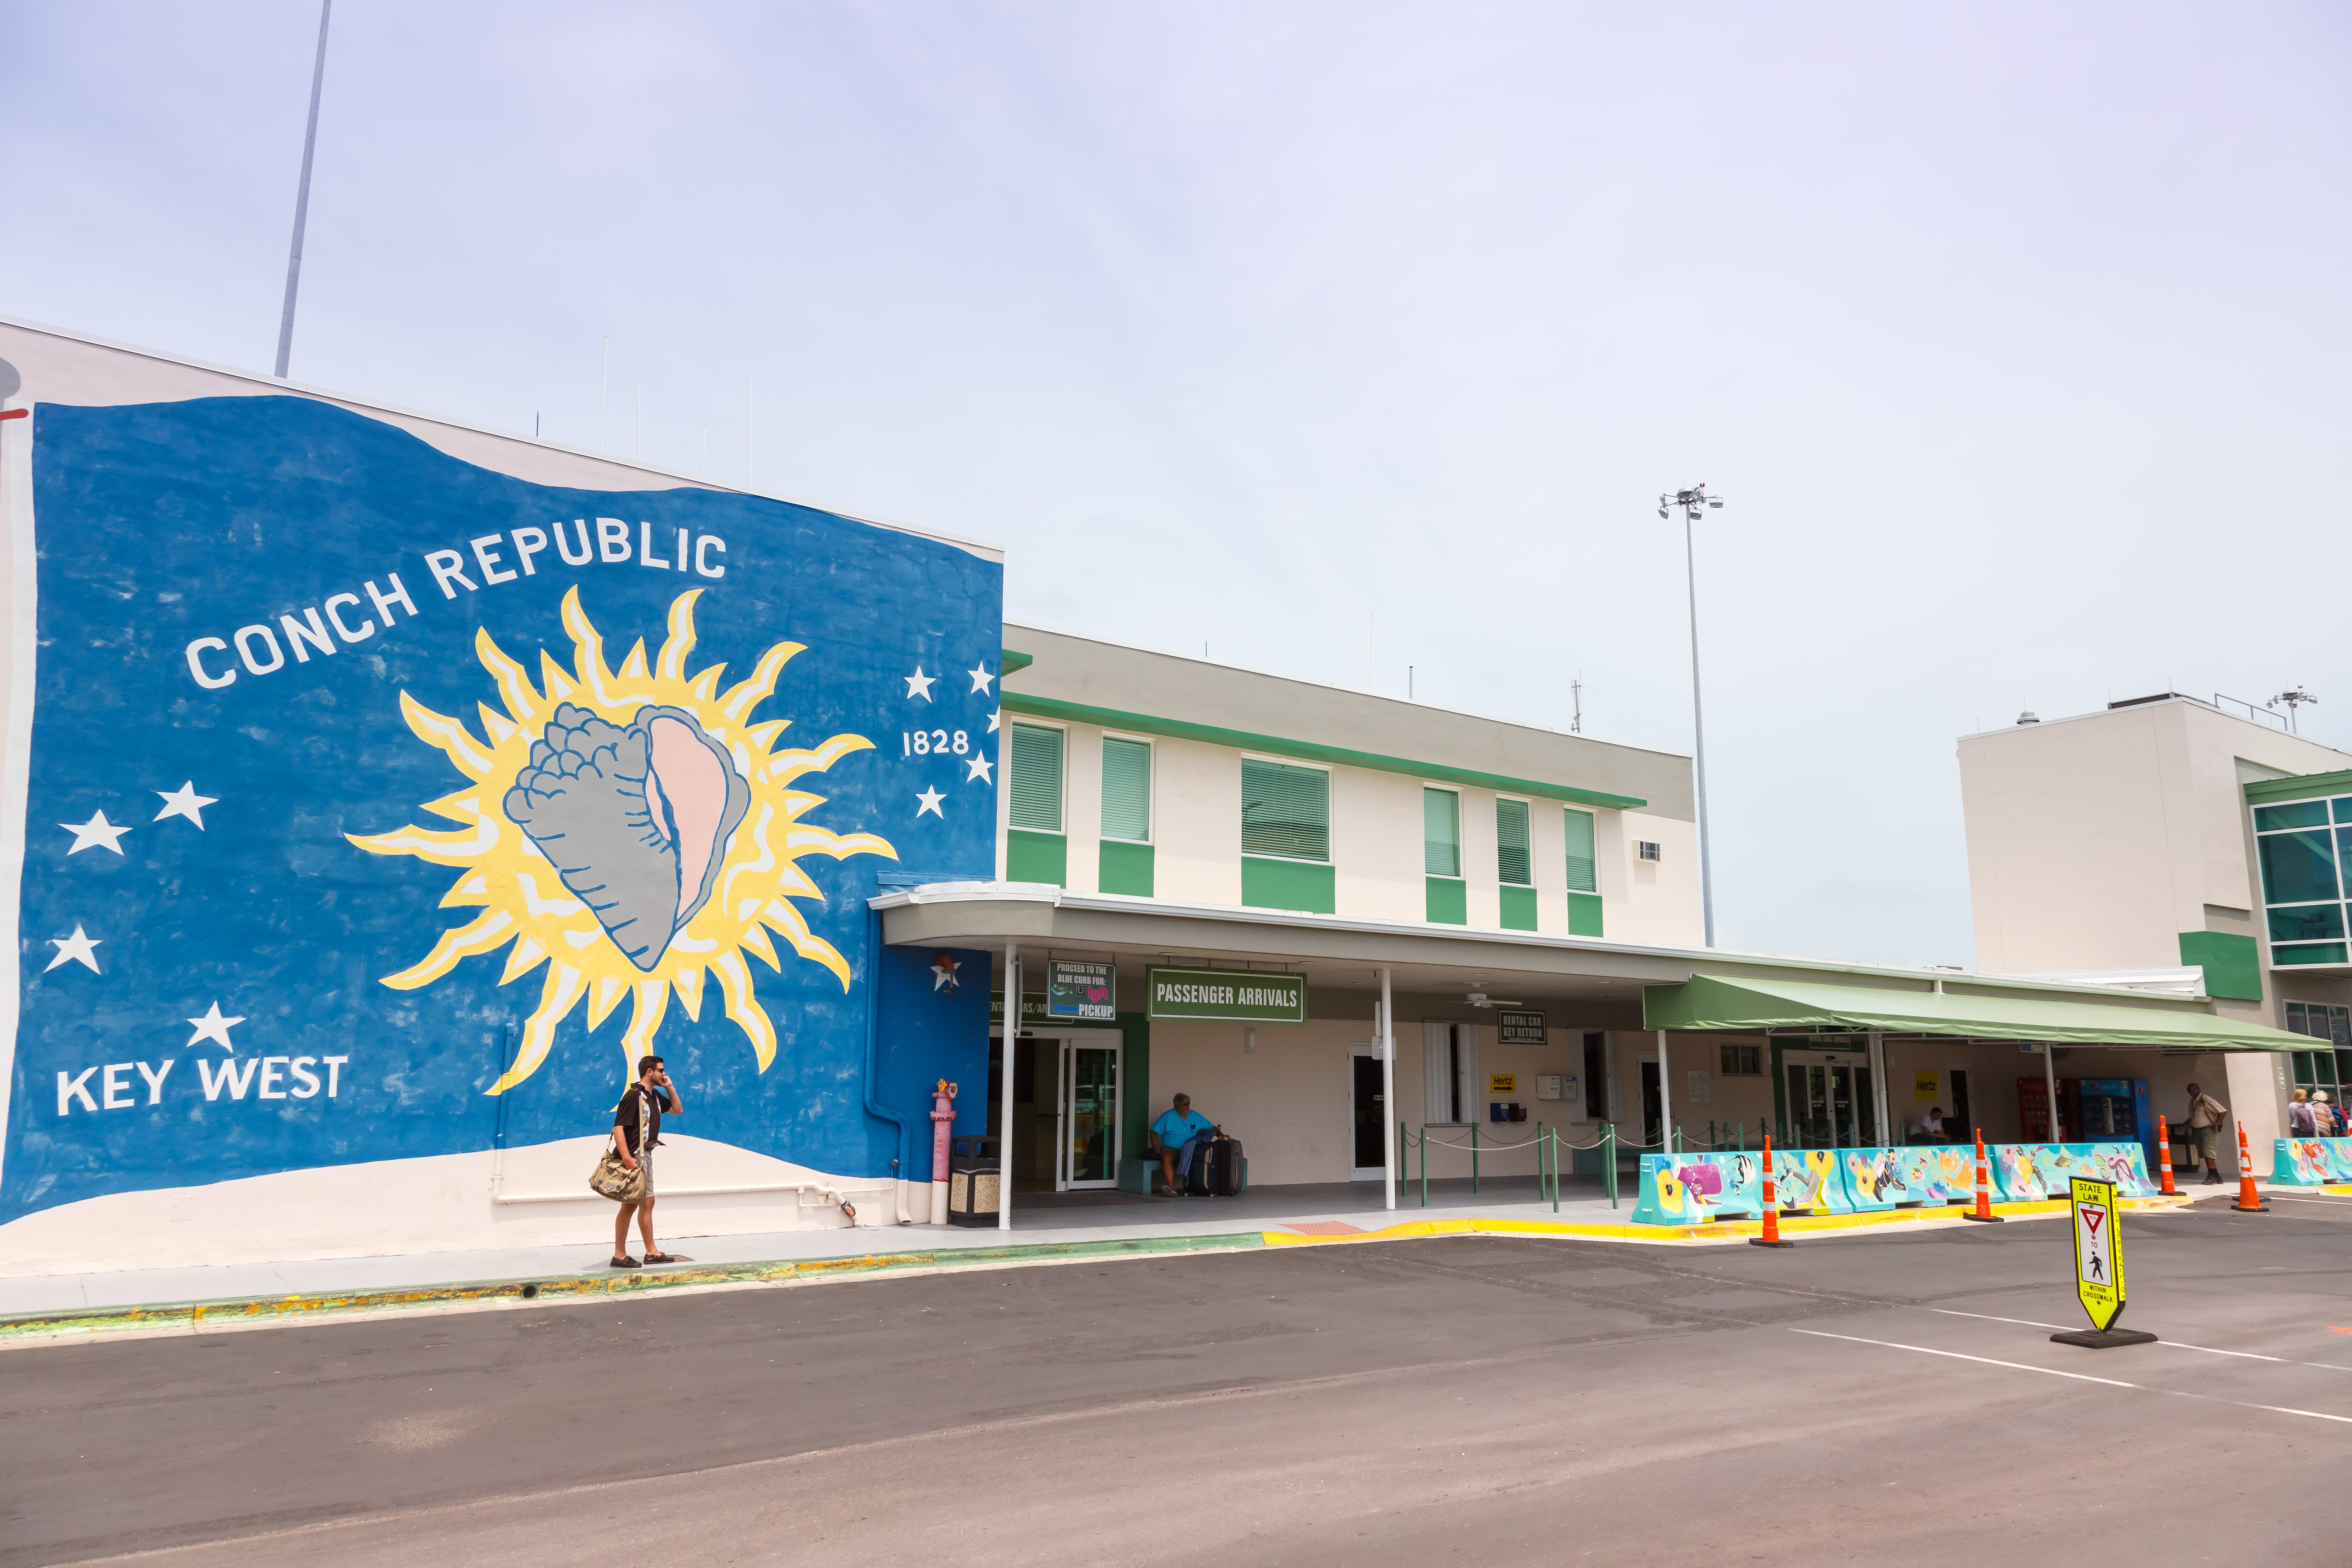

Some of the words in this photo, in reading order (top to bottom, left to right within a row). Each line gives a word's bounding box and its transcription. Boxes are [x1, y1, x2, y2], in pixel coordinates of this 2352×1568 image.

[186, 572, 419, 689] CONCH
[424, 517, 726, 599] REPUBLIC
[903, 729, 969, 756] 1828
[1057, 963, 1085, 973] PROCEED
[1086, 965, 1094, 973] TO
[1095, 966, 1107, 975] THE
[1058, 974, 1073, 983] BLUE
[1074, 975, 1091, 984] CURB
[1092, 977, 1106, 985] FOR:
[1088, 985, 1108, 1003] lyft
[1157, 983, 1234, 1004] PASSENGER
[1238, 987, 1297, 1007] ARRIVALS
[1079, 1004, 1113, 1017] PICKUP
[1503, 1016, 1527, 1026] RENTAL
[1528, 1016, 1541, 1026] CAR
[1503, 1027, 1515, 1036] KEY
[1517, 1028, 1542, 1038] RETURN
[57, 1059, 174, 1116] KEY
[197, 1056, 348, 1101] WEST
[1493, 1076, 1512, 1085] Hertz
[1917, 1080, 1936, 1091] Hertz
[2079, 1183, 2102, 1194] STATE
[2083, 1193, 2098, 1202] LAW
[2089, 1285, 2107, 1294] WITHIN
[2083, 1291, 2113, 1303] CROSSWALK
